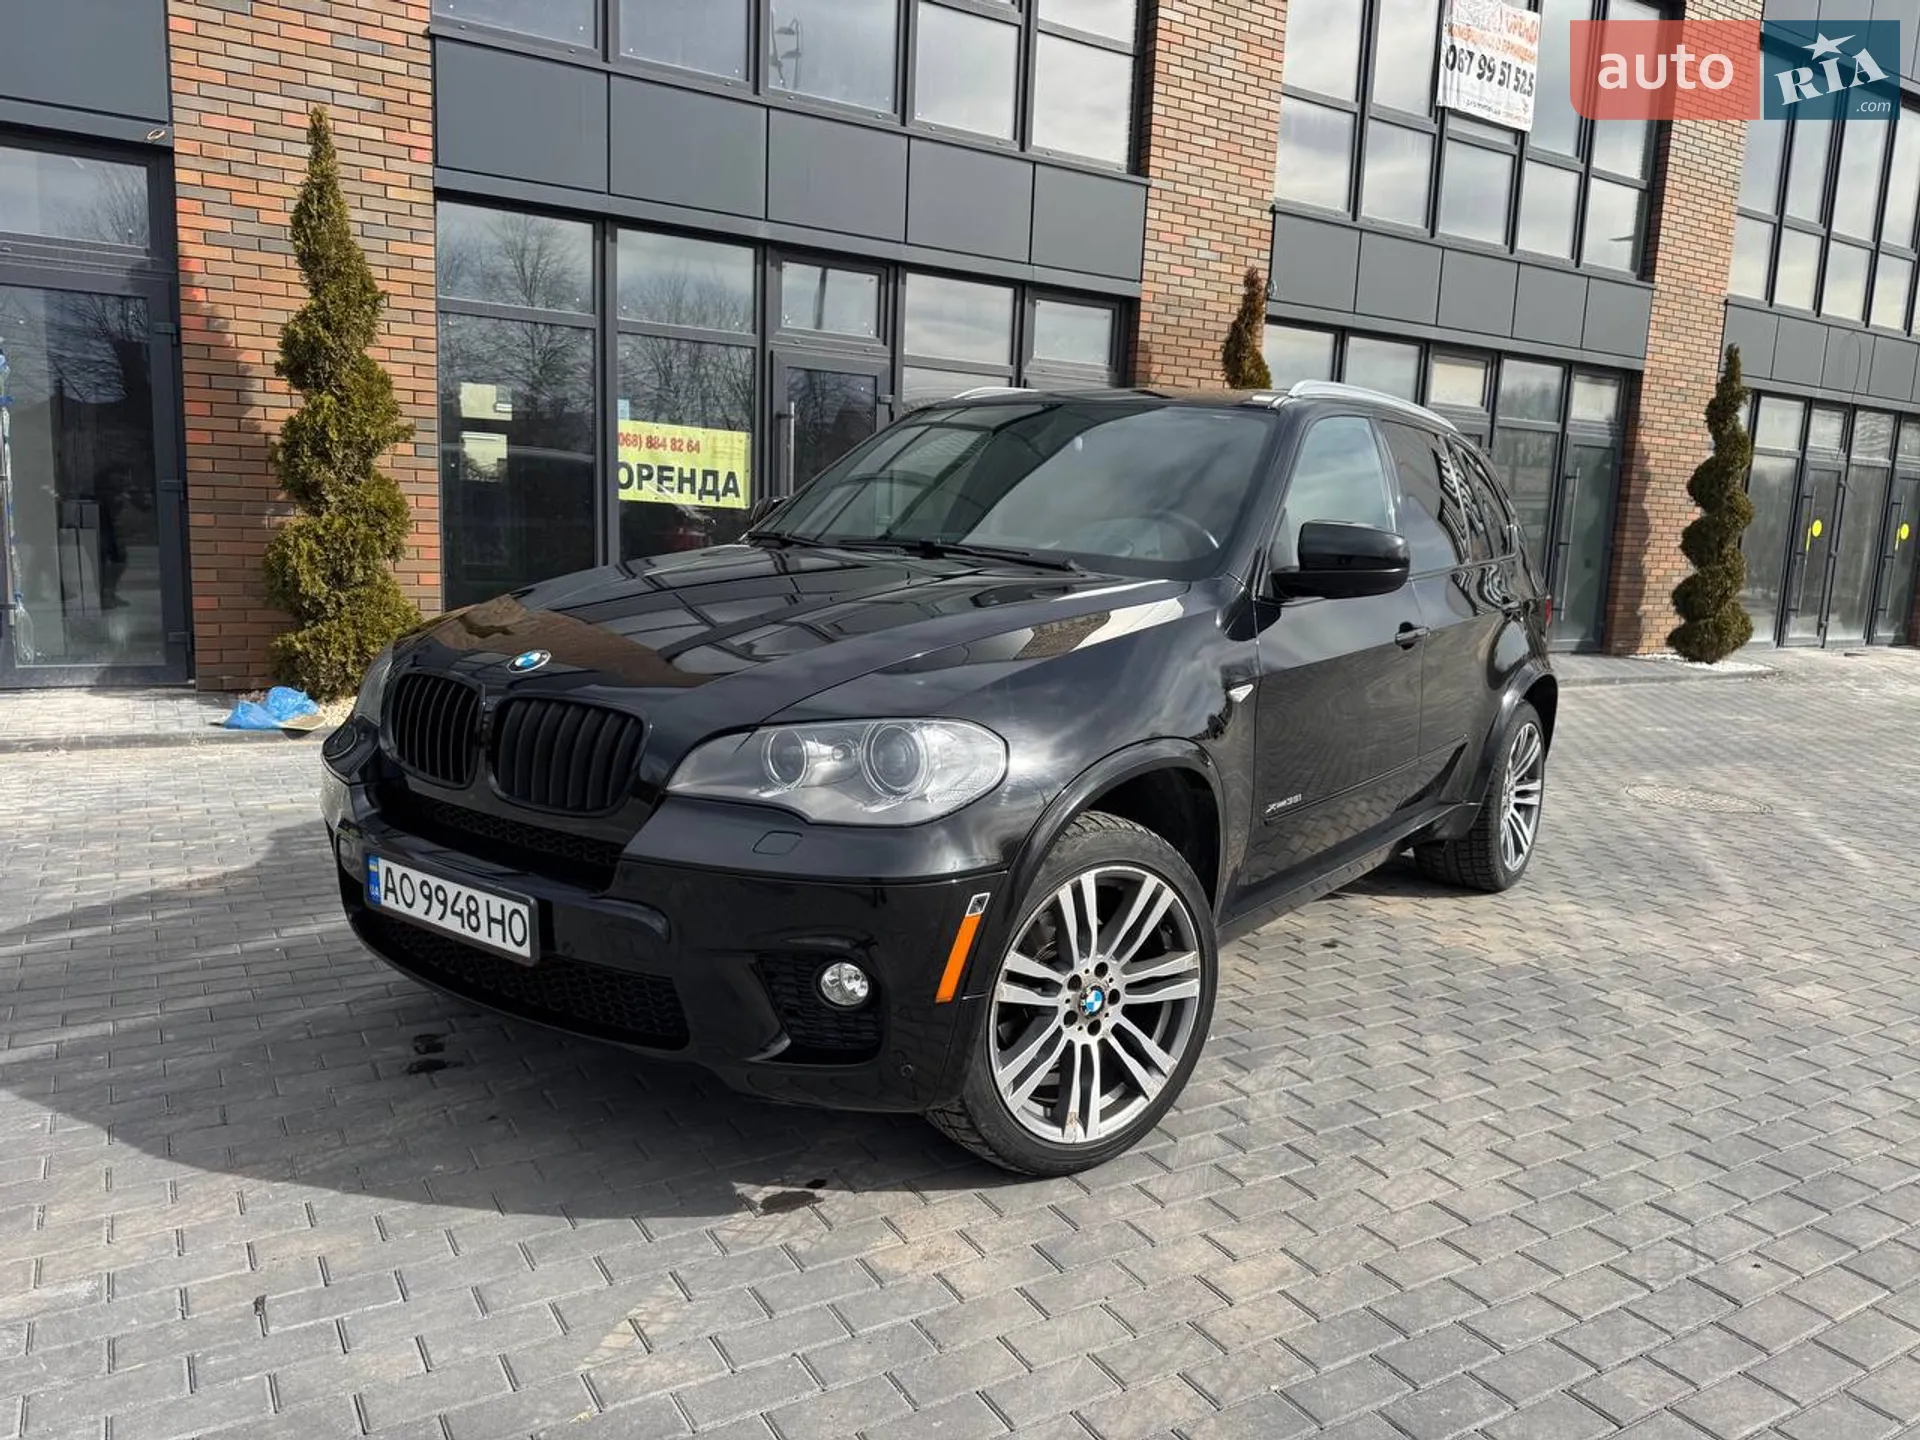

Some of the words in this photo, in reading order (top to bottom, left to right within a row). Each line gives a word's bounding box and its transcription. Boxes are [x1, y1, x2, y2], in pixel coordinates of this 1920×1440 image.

[1445, 44, 1475, 76] 067
[1476, 54, 1496, 83] 99
[1498, 60, 1512, 89] 51
[670, 437, 684, 452] 82
[617, 461, 741, 502] ОРЕНДА
[419, 879, 481, 933] 9948
